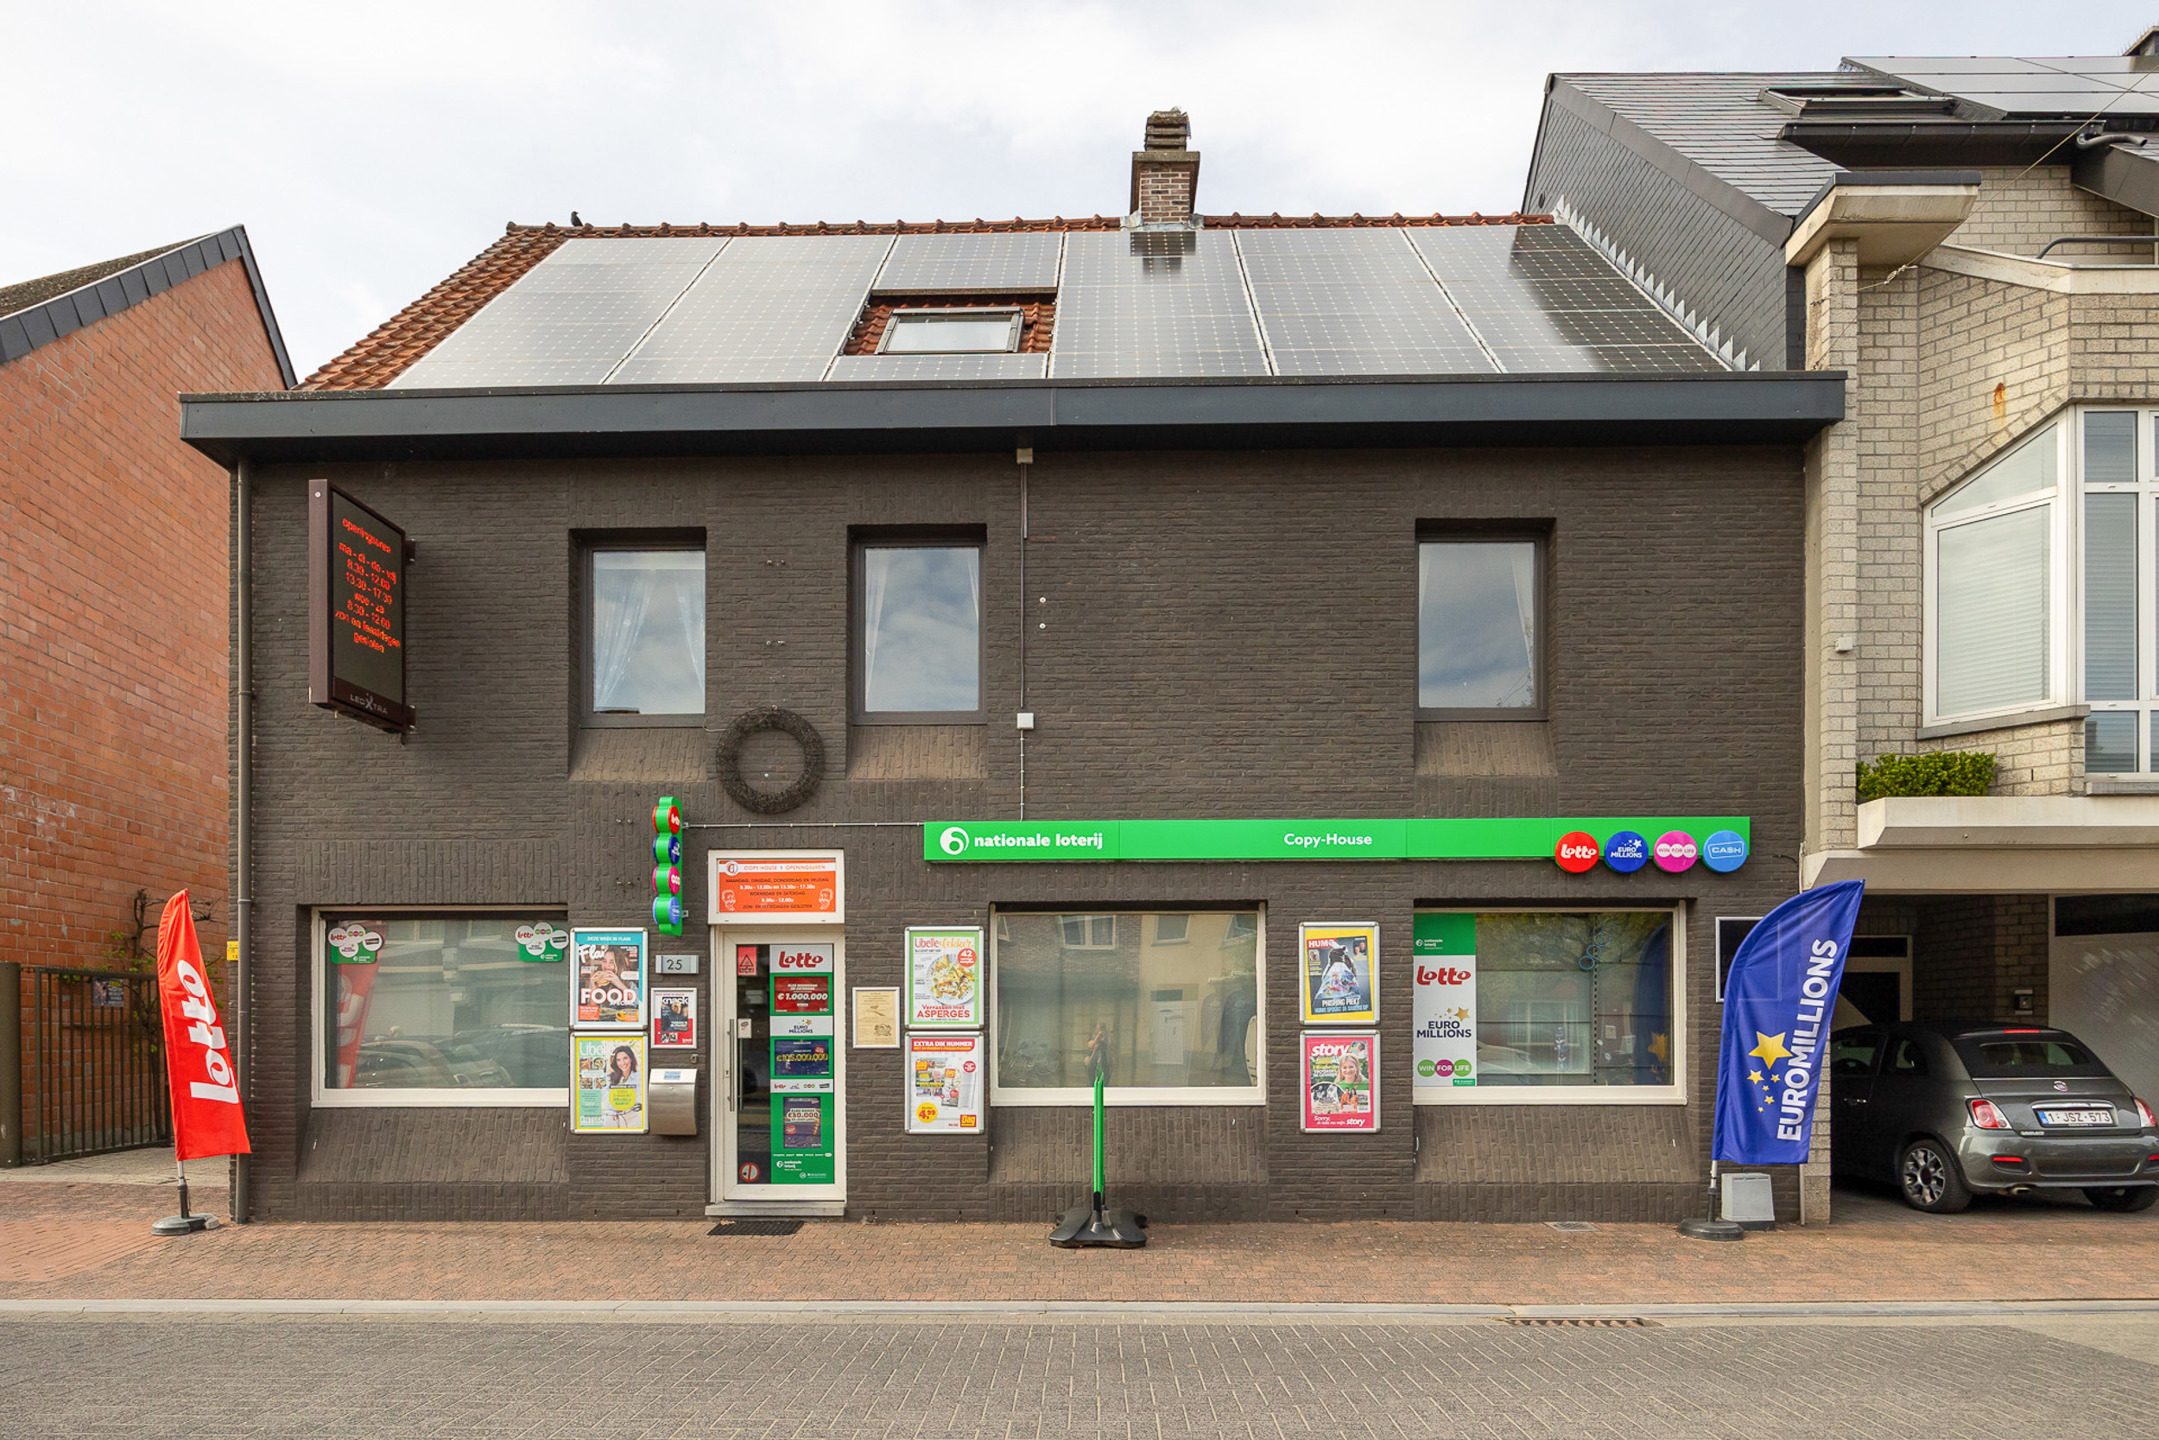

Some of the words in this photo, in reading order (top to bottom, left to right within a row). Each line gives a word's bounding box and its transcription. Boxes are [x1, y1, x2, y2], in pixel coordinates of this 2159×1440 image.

[974, 833, 1050, 847] nationale
[1056, 832, 1103, 850] loterij
[1284, 833, 1372, 848] Copy-House
[666, 959, 682, 970] 25
[581, 988, 636, 1004] FOOD
[1428, 1021, 1460, 1029] EURO
[1417, 1029, 1472, 1038] MILLIONS
[1777, 939, 1838, 1141] EUROMILLIONS
[1311, 1044, 1350, 1056] story
[1346, 1118, 1365, 1127] story
